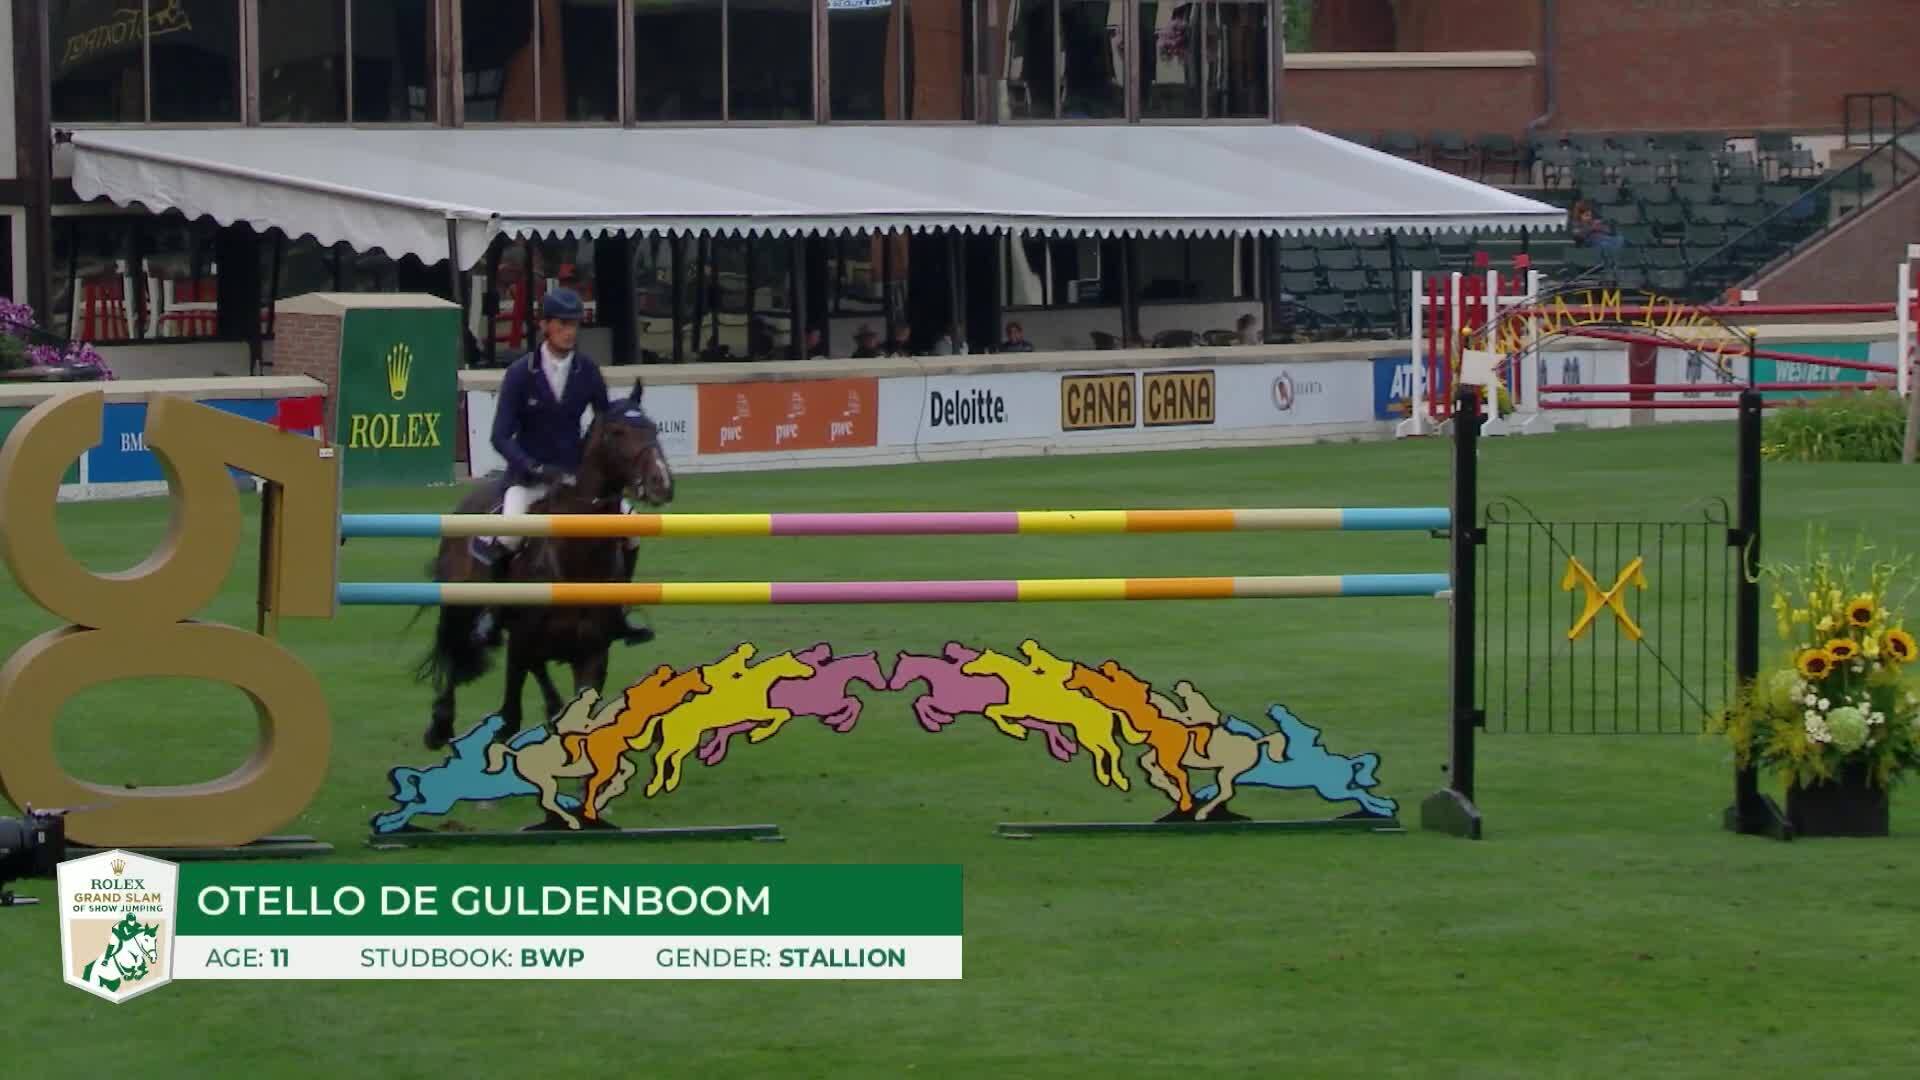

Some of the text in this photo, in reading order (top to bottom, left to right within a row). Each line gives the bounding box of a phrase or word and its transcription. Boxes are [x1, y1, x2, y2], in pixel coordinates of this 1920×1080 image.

[1067, 381, 1133, 424] CANA
[1149, 378, 1210, 419] CANA
[350, 413, 440, 448] ROLEX
[720, 425, 743, 447] pwc
[775, 423, 799, 445] pwc
[831, 420, 854, 441] pwc
[120, 432, 151, 452] BM
